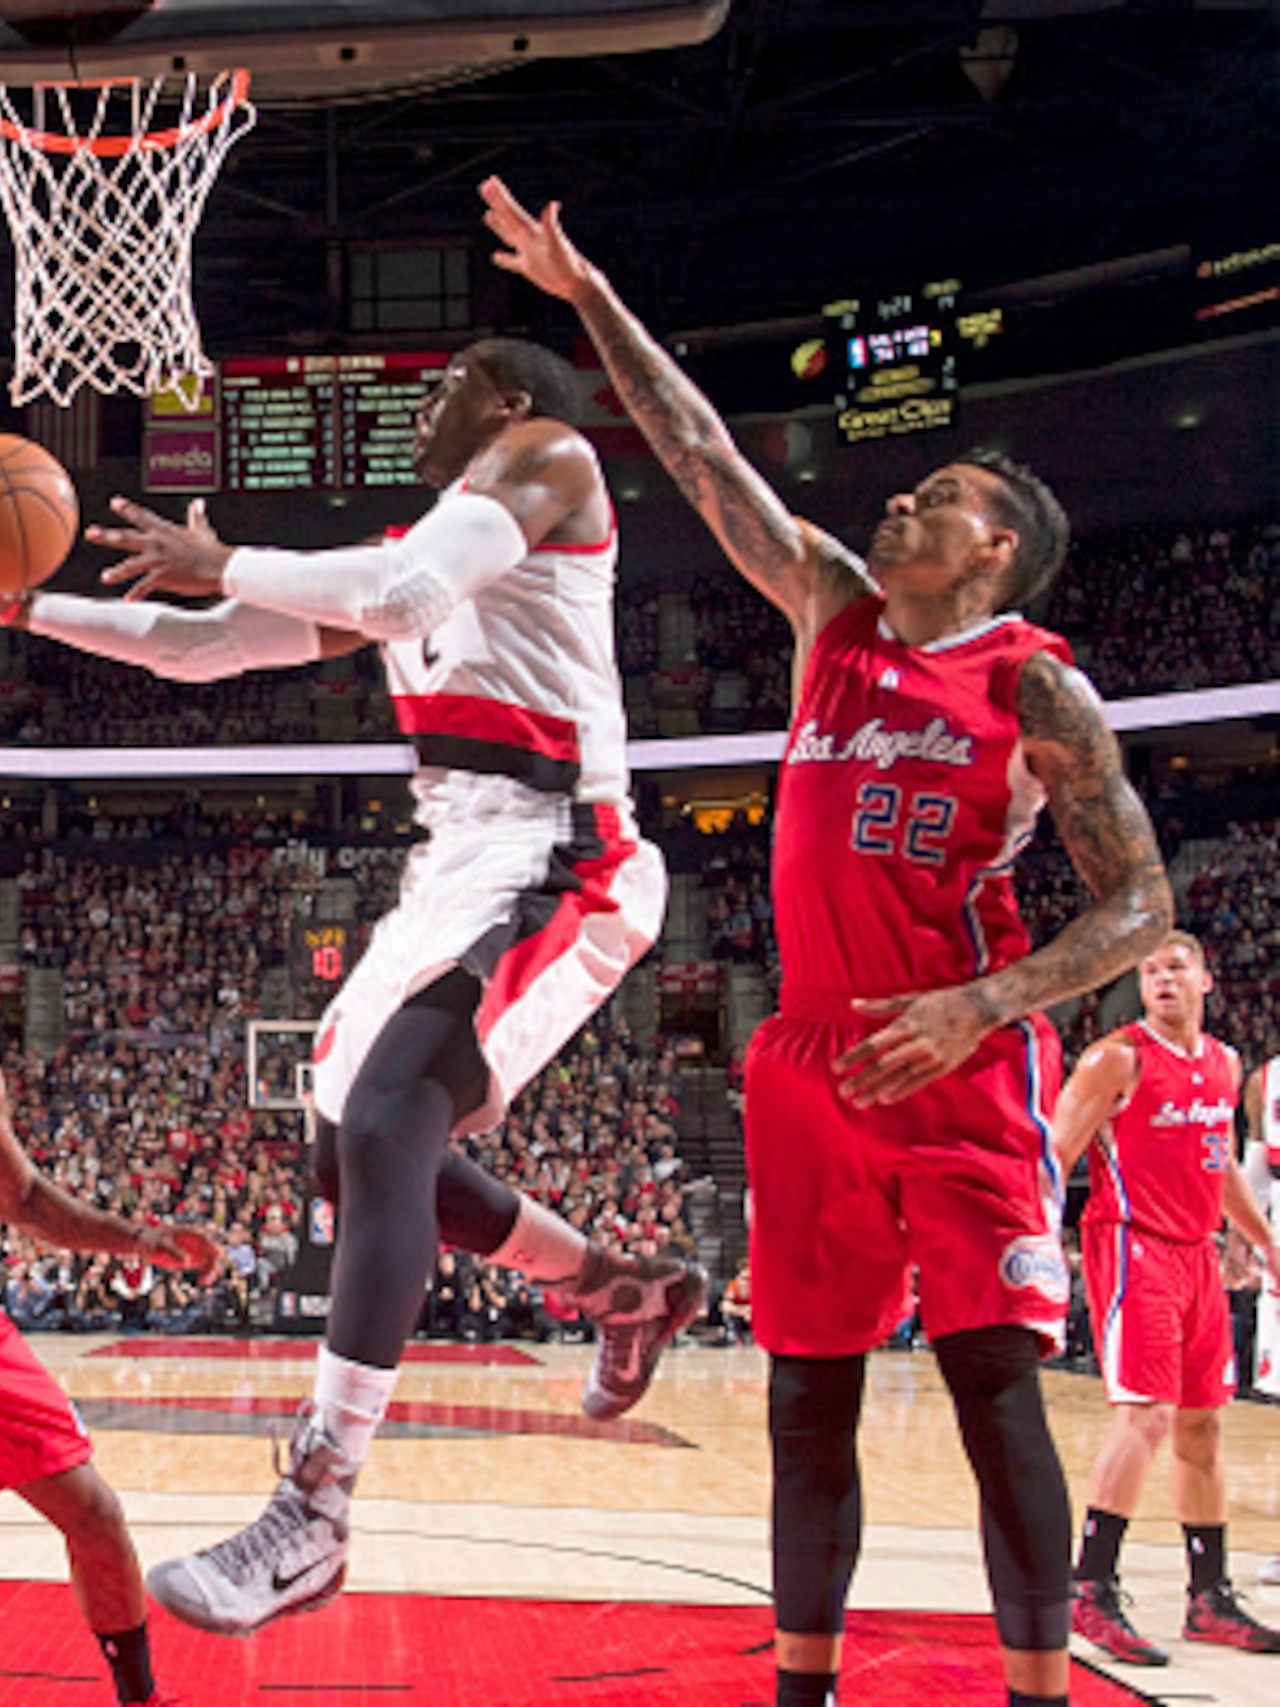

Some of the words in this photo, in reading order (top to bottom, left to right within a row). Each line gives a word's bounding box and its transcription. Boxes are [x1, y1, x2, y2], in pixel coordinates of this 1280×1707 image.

[788, 717, 838, 765] Los
[837, 717, 973, 770] Angeles
[852, 781, 959, 867] 22
